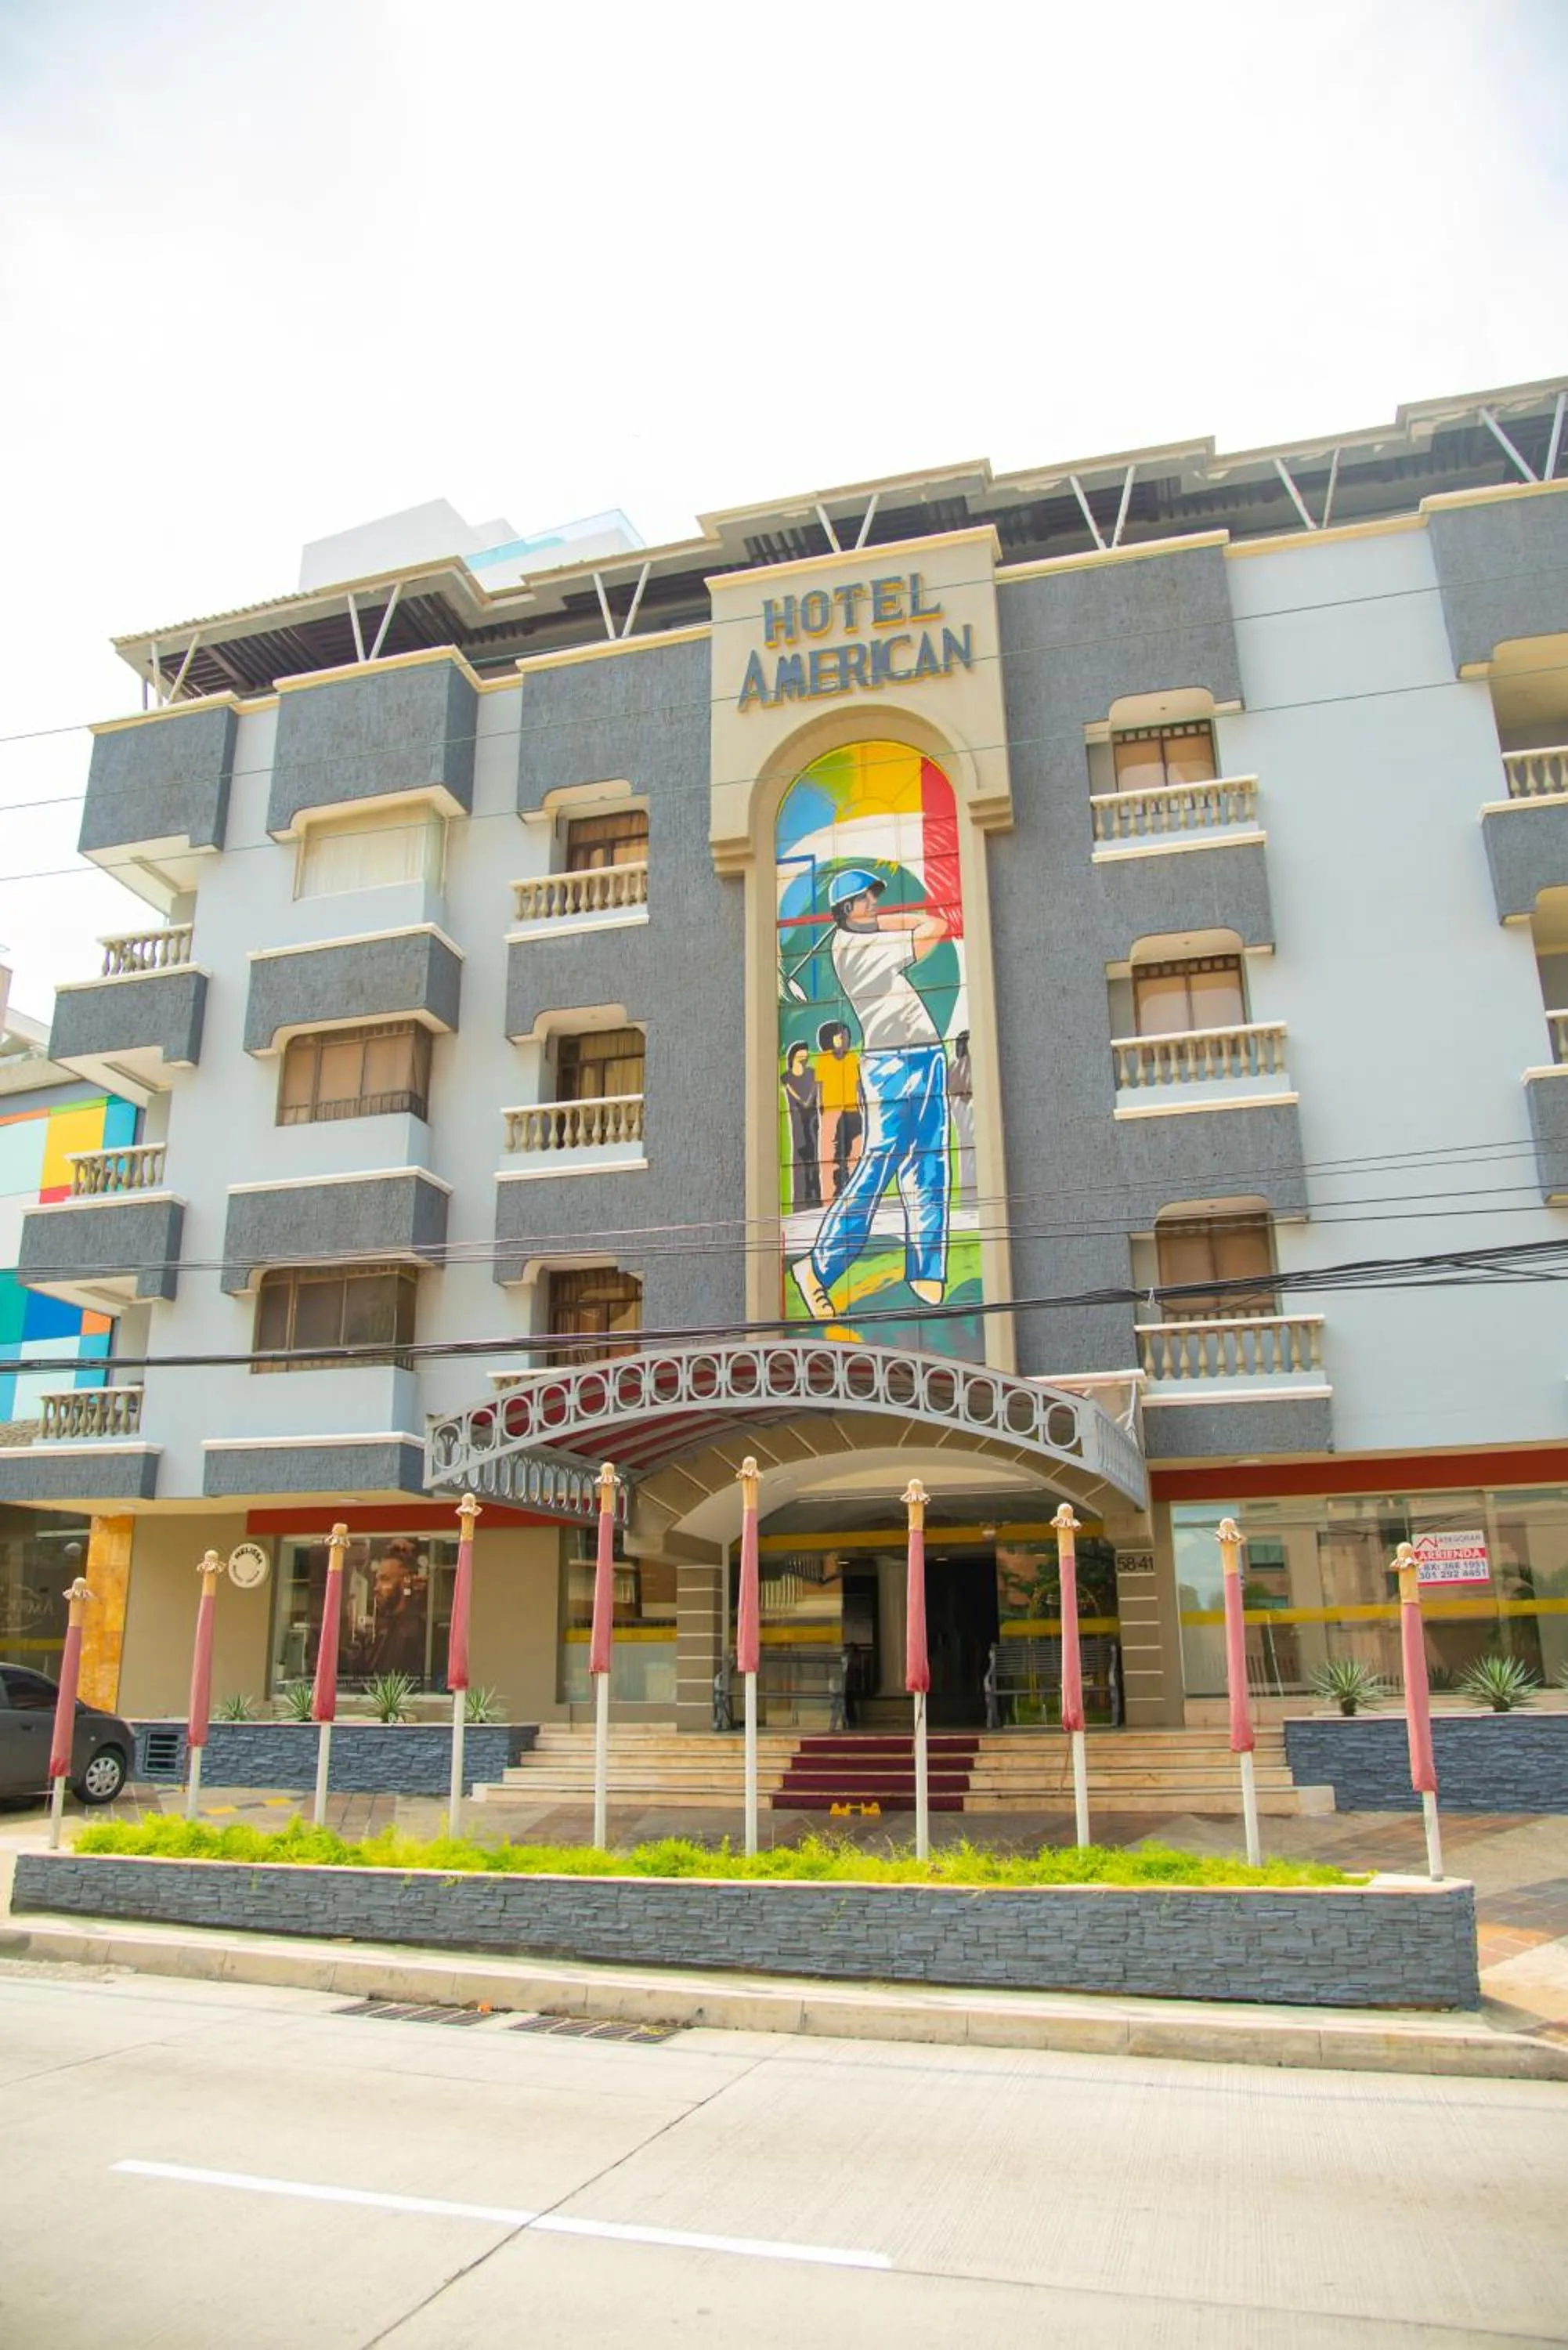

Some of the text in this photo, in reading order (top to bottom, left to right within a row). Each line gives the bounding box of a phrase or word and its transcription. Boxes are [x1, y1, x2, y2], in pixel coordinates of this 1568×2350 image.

[762, 573, 943, 648] HOTEL
[738, 624, 973, 713] AMERICAN
[1420, 1548, 1480, 1560] ARRIENDA
